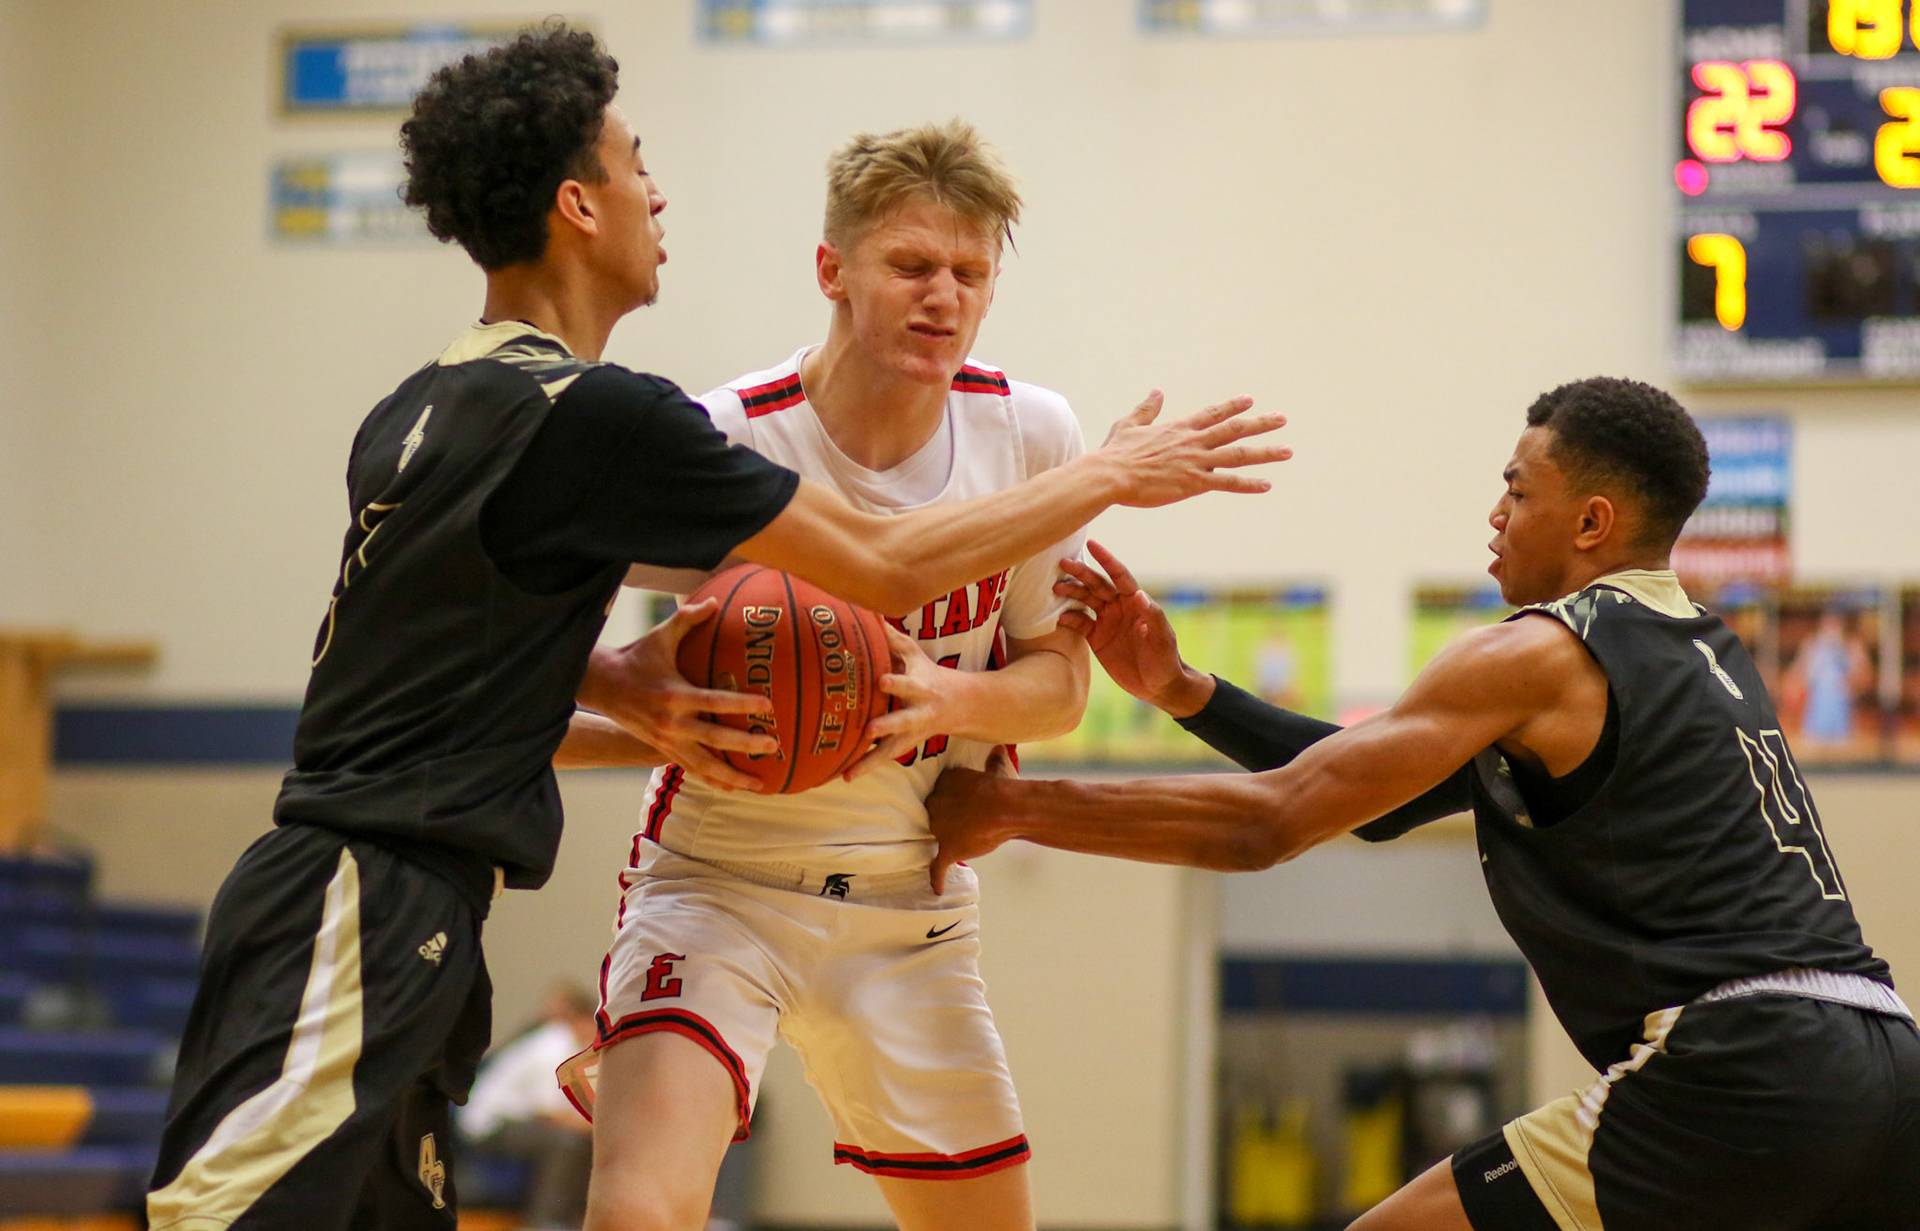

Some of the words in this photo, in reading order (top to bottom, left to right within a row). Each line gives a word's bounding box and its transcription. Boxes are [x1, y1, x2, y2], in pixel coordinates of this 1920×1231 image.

[1687, 59, 1797, 163] 22
[1688, 233, 1747, 331] 7
[811, 605, 846, 755] TF-1000
[641, 952, 686, 1002] E
